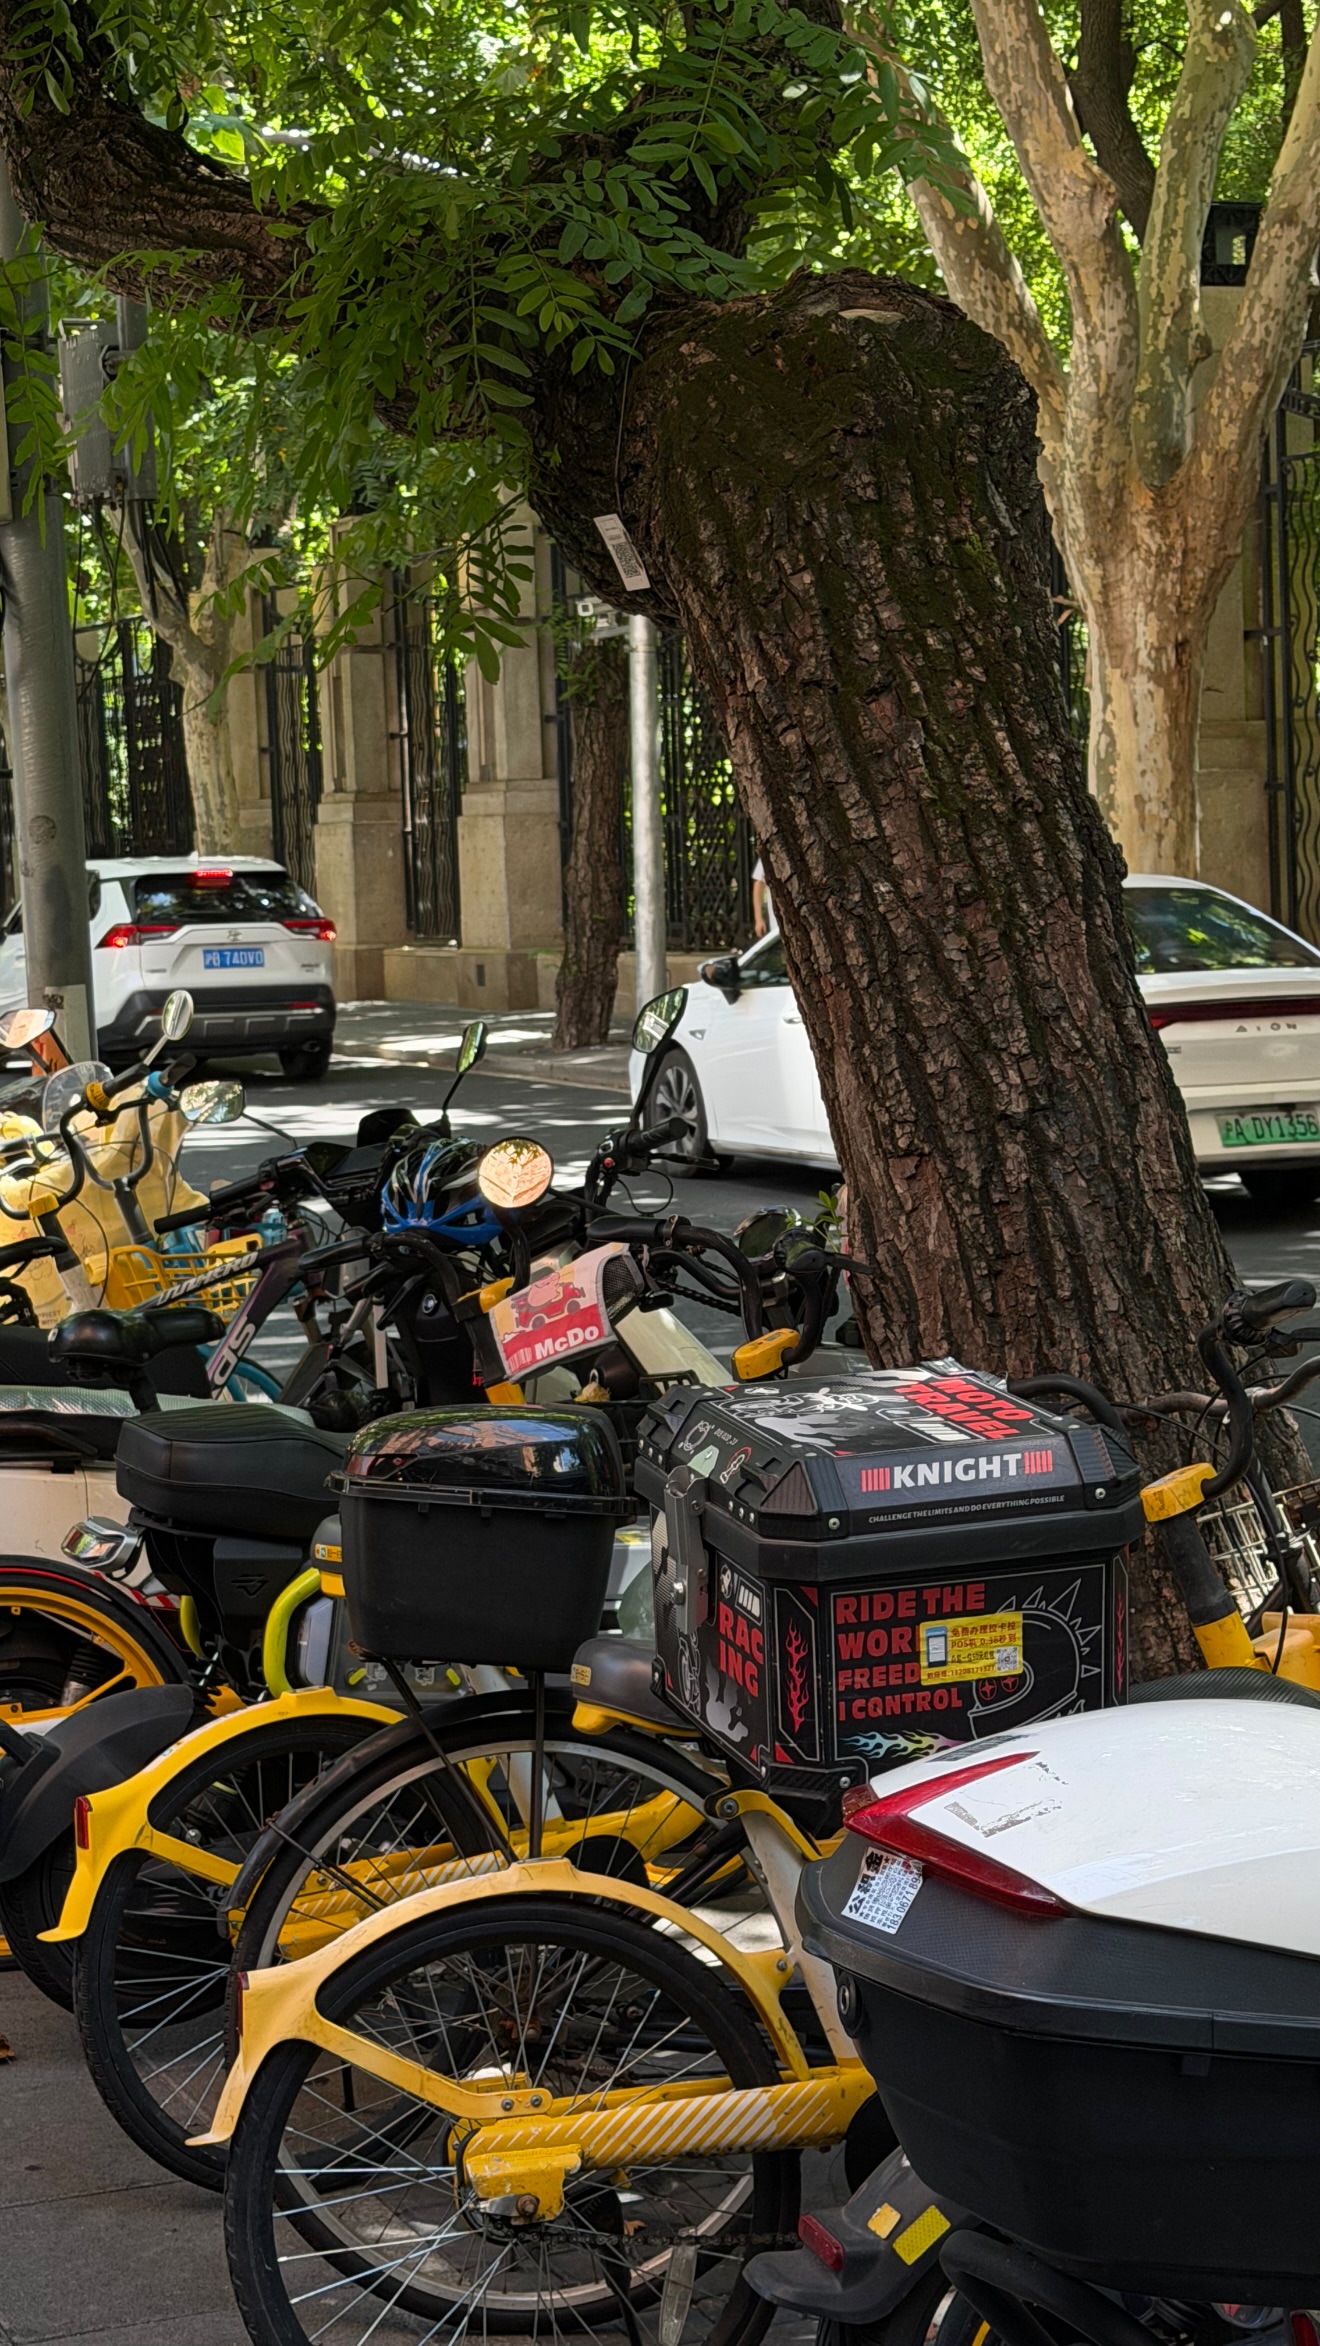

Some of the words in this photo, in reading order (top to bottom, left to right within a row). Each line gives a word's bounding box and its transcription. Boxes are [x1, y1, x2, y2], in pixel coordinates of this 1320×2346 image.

[534, 1325, 599, 1361] McDo
[894, 1383, 1020, 1439] TRAVEL
[929, 1379, 1034, 1420] MOTO
[893, 1452, 1022, 1489] KNIGHT
[868, 1511, 912, 1524] CHALLENGE
[913, 1510, 928, 1519] THE
[928, 1506, 953, 1517] LIMITS
[953, 1504, 970, 1514] AND
[970, 1504, 982, 1512] DO
[982, 1499, 1030, 1511] EVERYTHING
[1030, 1495, 1065, 1505] POSSIBLE
[836, 1590, 916, 1625] RIDE
[922, 1583, 985, 1615] THE
[719, 1602, 764, 1665] RAC
[719, 1639, 759, 1698] ING
[838, 1701, 846, 1722] I
[852, 1687, 963, 1719] CONTROL
[887, 1912, 902, 1930] 183
[896, 1890, 914, 1913] 0671
